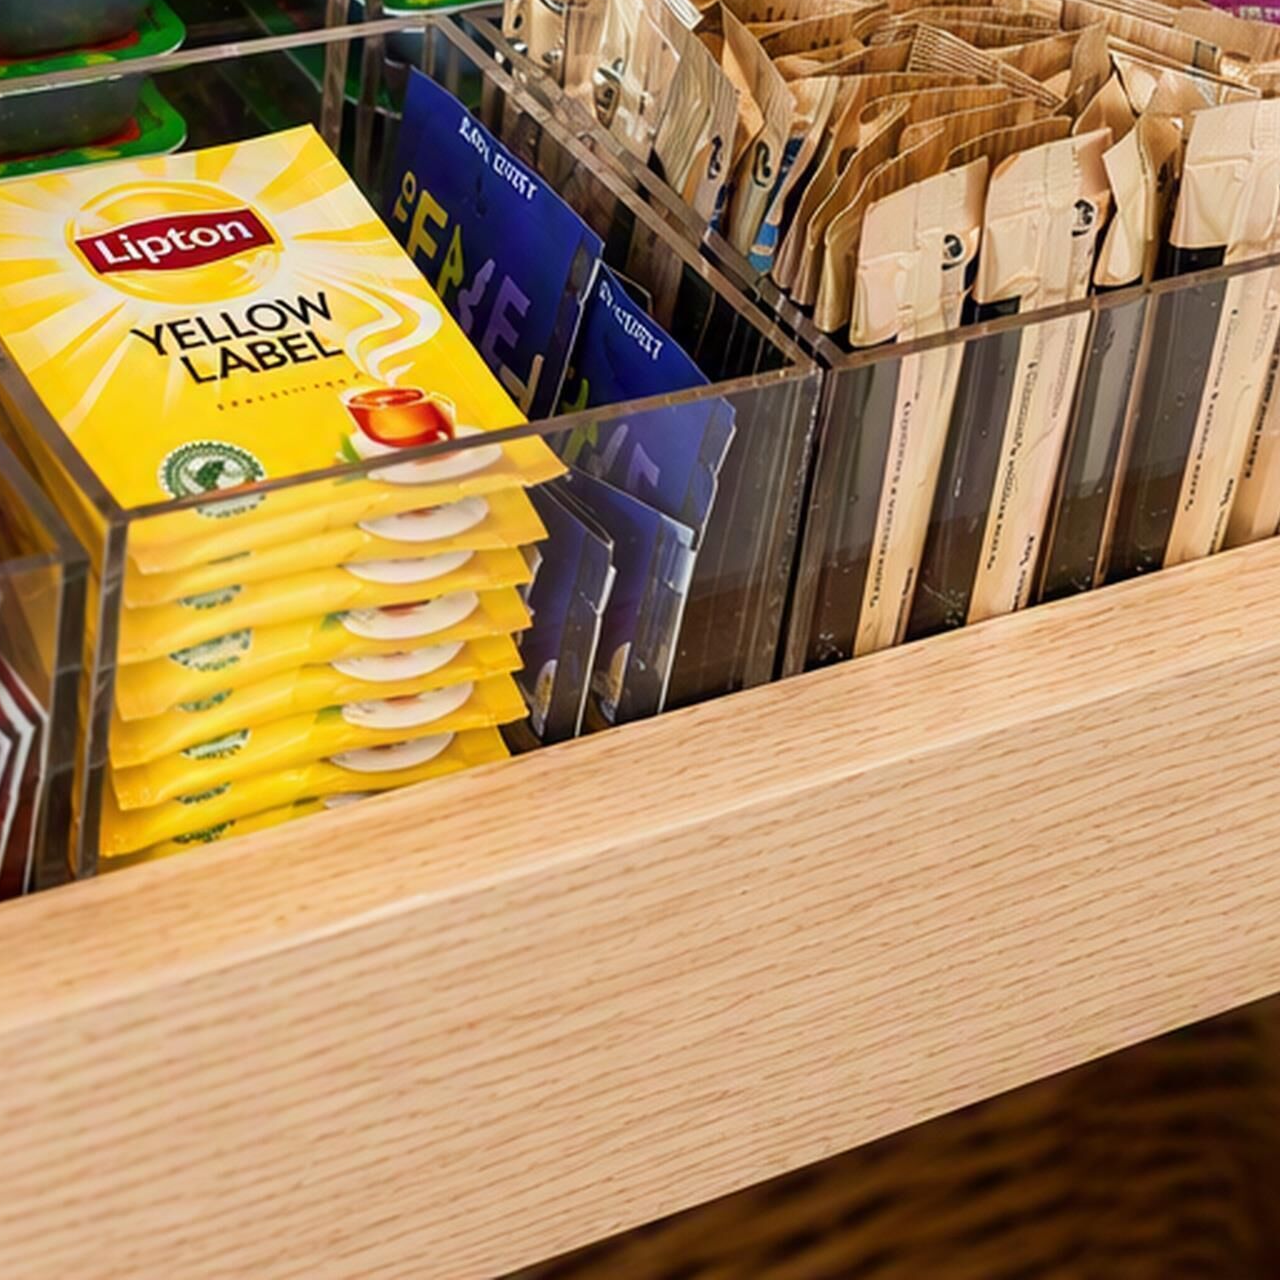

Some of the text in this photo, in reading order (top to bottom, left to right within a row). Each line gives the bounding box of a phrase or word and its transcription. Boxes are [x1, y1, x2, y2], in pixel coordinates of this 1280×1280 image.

[94, 220, 253, 264] Lipton
[130, 291, 332, 356] YELLOW
[180, 331, 344, 385] LABEL
